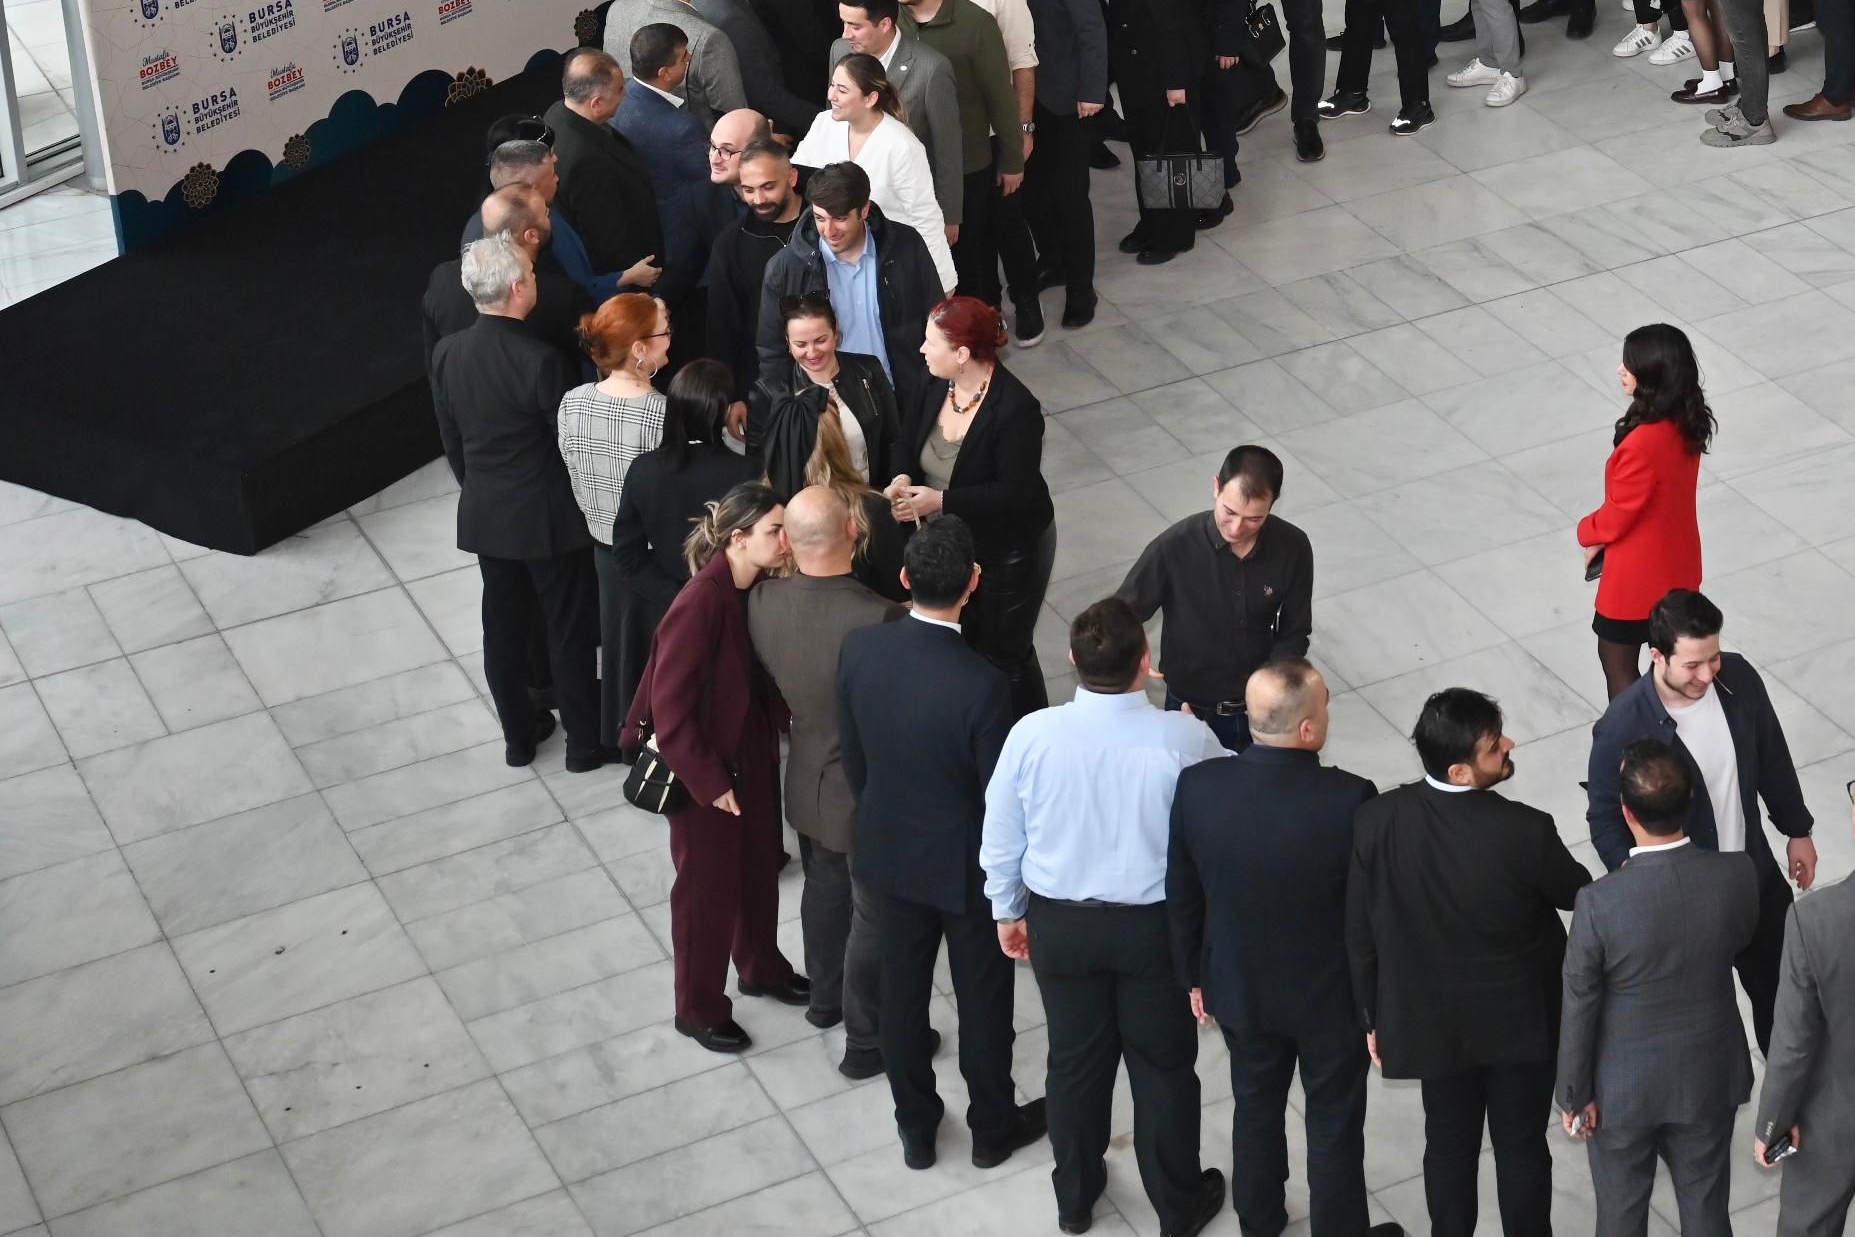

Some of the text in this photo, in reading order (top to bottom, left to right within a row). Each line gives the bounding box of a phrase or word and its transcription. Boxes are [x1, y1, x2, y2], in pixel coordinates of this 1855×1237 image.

[369, 11, 410, 37] BURSA
[139, 55, 178, 79] BOZBEY
[267, 67, 303, 90] BOZBEY
[192, 87, 236, 114] BURSA
